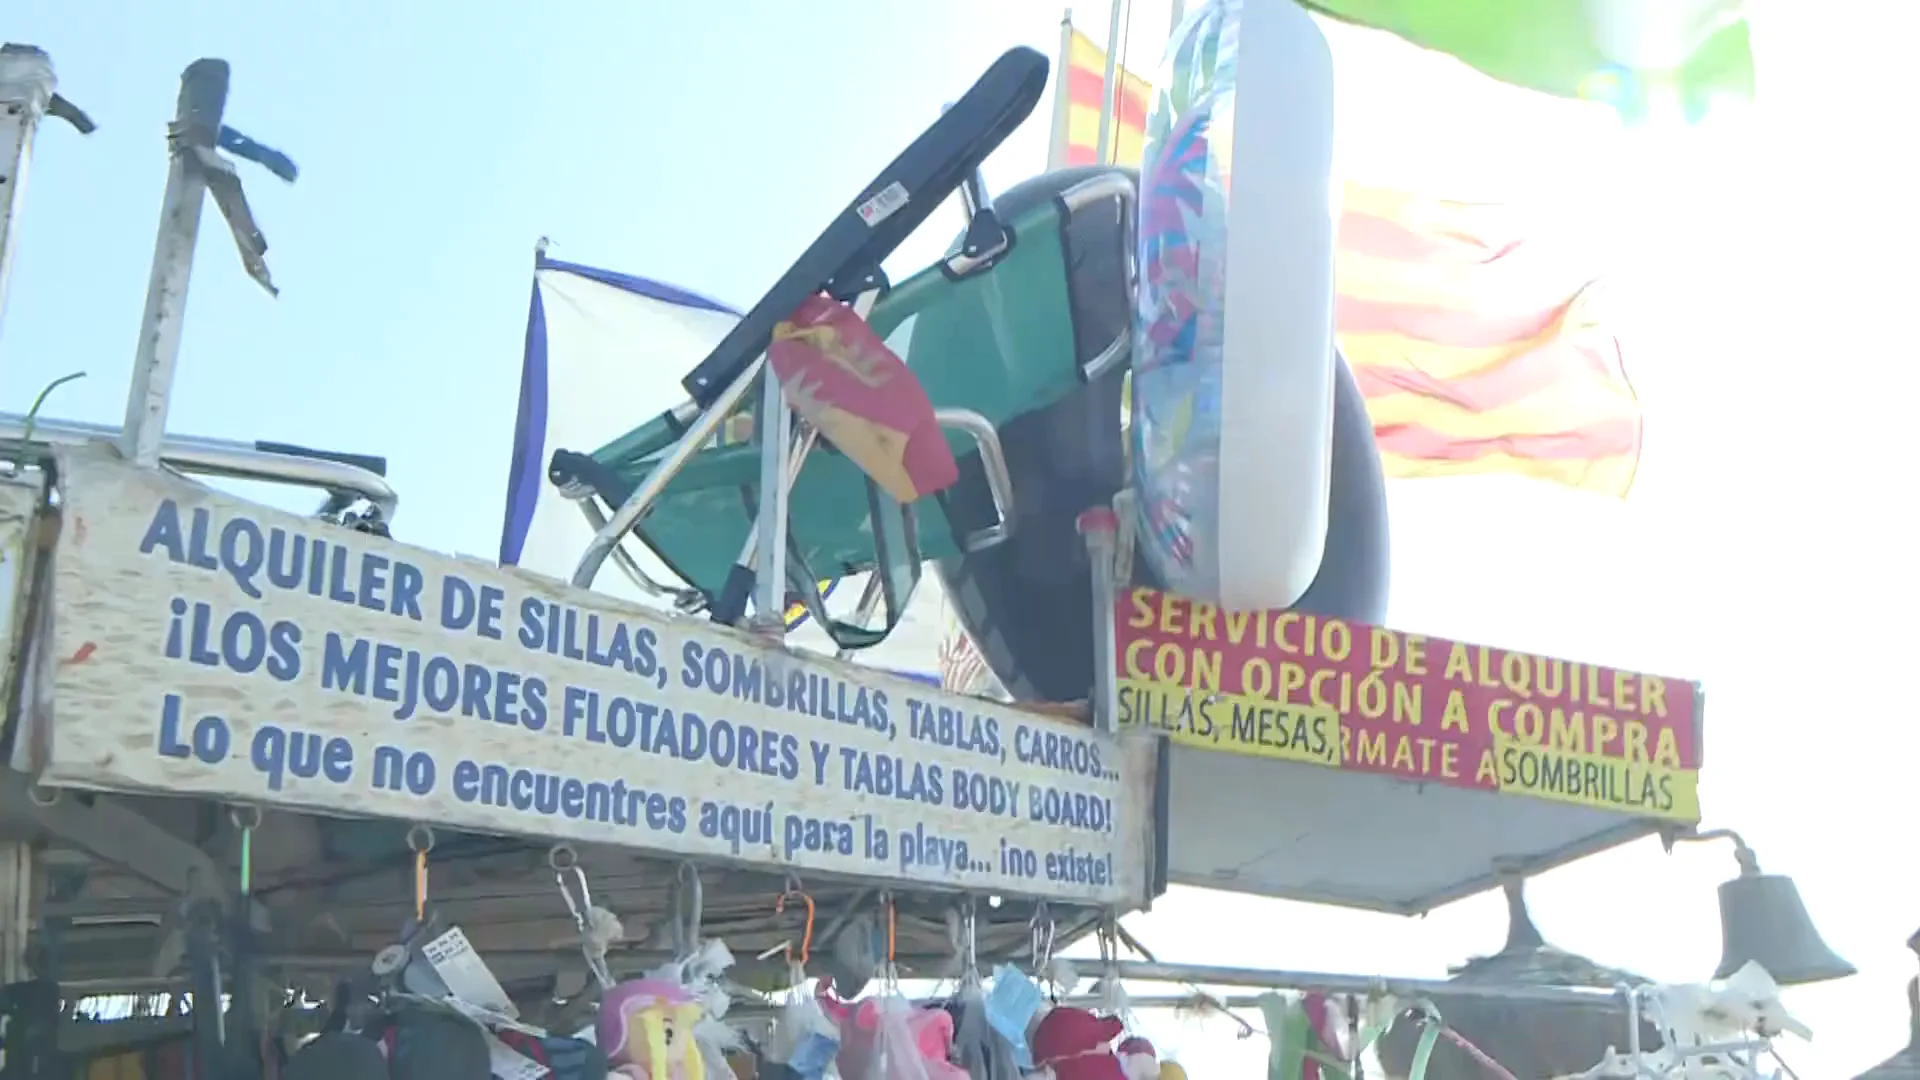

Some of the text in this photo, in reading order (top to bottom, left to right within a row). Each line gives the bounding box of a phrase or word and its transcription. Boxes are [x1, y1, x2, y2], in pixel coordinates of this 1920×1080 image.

[139, 499, 424, 622] ALQUILER
[440, 576, 503, 641] DE
[518, 596, 667, 689] SILLAS,
[681, 640, 896, 740] SOMBRILLAS,
[906, 698, 1006, 765] TABLAS,
[1128, 587, 1668, 718] SERVICIO DE ALQUILER
[165, 597, 1112, 832] ¡LOS MEJORES FLOTADORES Y TABLAS BODY BOARD!
[1117, 685, 1334, 763] SILLAS, MESAS,
[1125, 640, 1680, 770] CON OPCIÓN A COMPRA
[158, 693, 230, 764] Lo
[251, 725, 353, 791] que
[371, 746, 436, 795] no
[453, 759, 686, 834] encuentres
[699, 801, 773, 855] aquí
[784, 815, 853, 857] para
[864, 815, 888, 860] la
[1502, 747, 1674, 811] SOMBRILLAS
